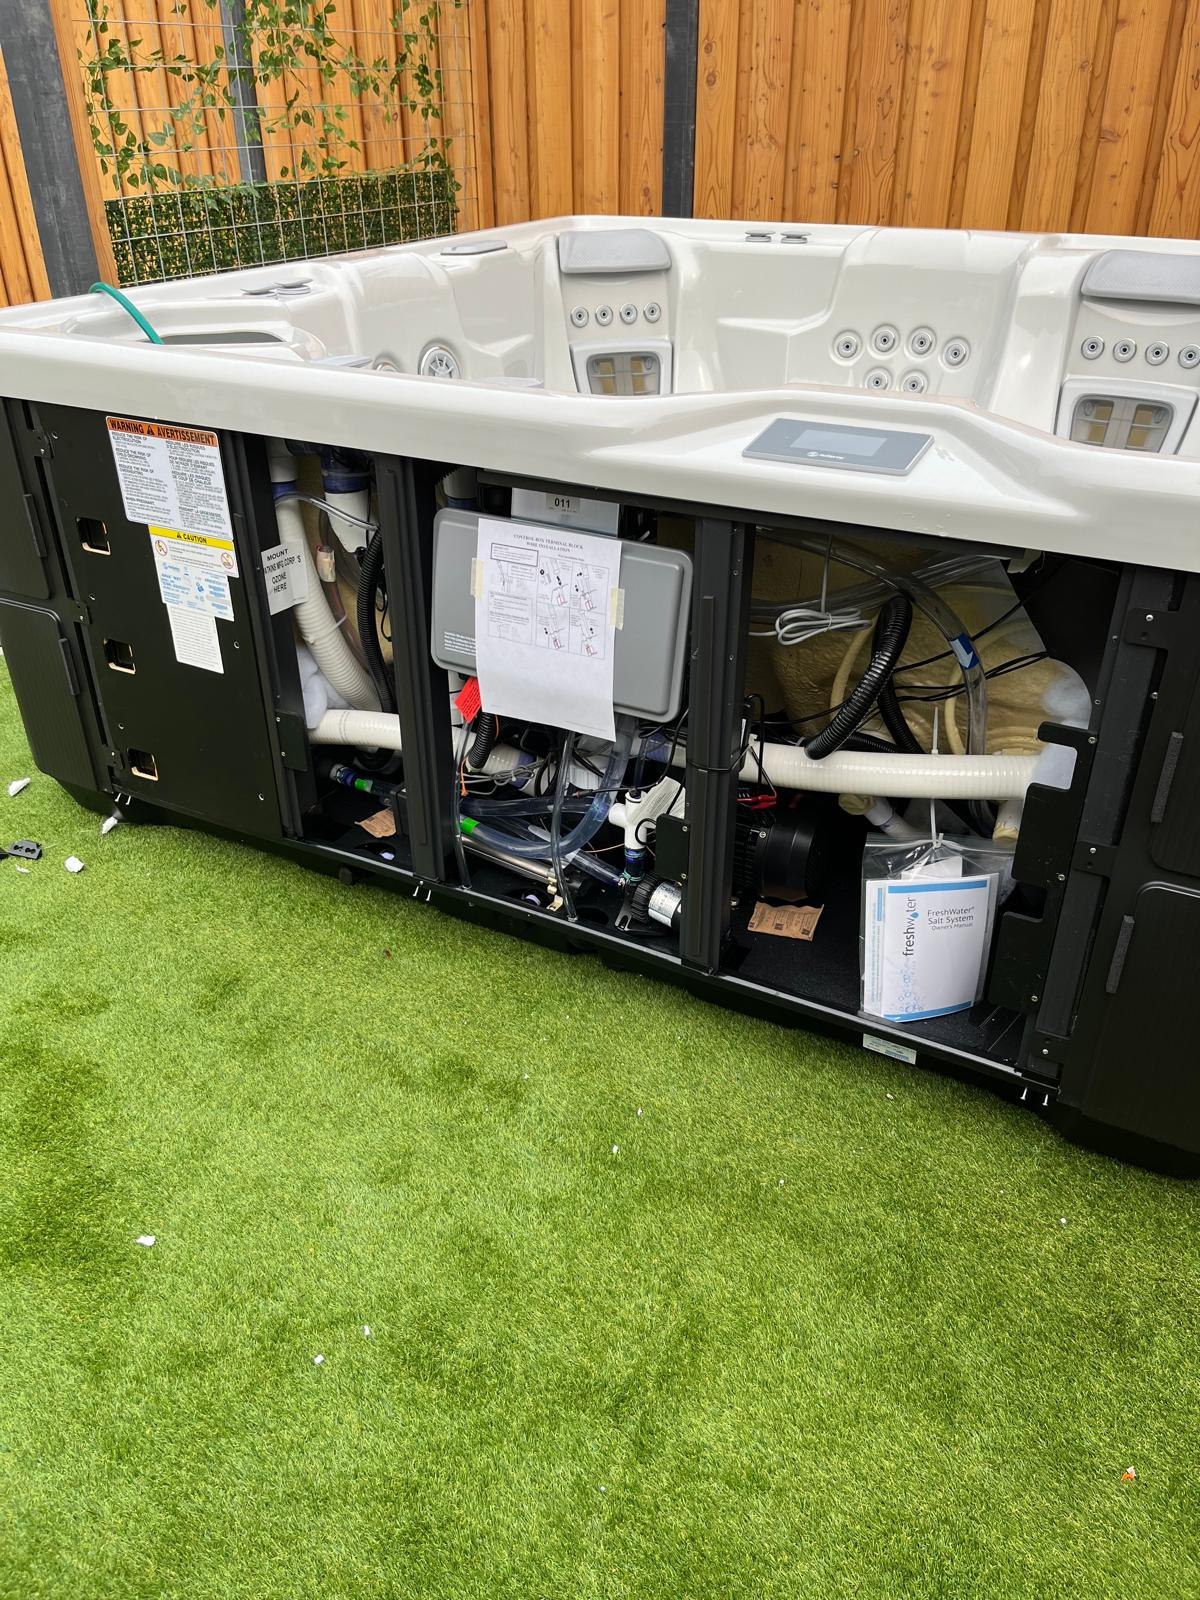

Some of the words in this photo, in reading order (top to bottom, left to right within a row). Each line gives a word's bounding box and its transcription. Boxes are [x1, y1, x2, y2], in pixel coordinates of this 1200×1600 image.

[110, 420, 144, 434] WARNING
[157, 427, 215, 445] AVERTISSEMENT
[554, 497, 571, 509] 011
[183, 533, 207, 545] CAUTION
[568, 542, 584, 550] BLOCK
[266, 549, 288, 562] MOUNT
[273, 582, 287, 594] HERE
[928, 917, 944, 926] Salt
[945, 915, 974, 925] System
[931, 923, 953, 931] Owner's
